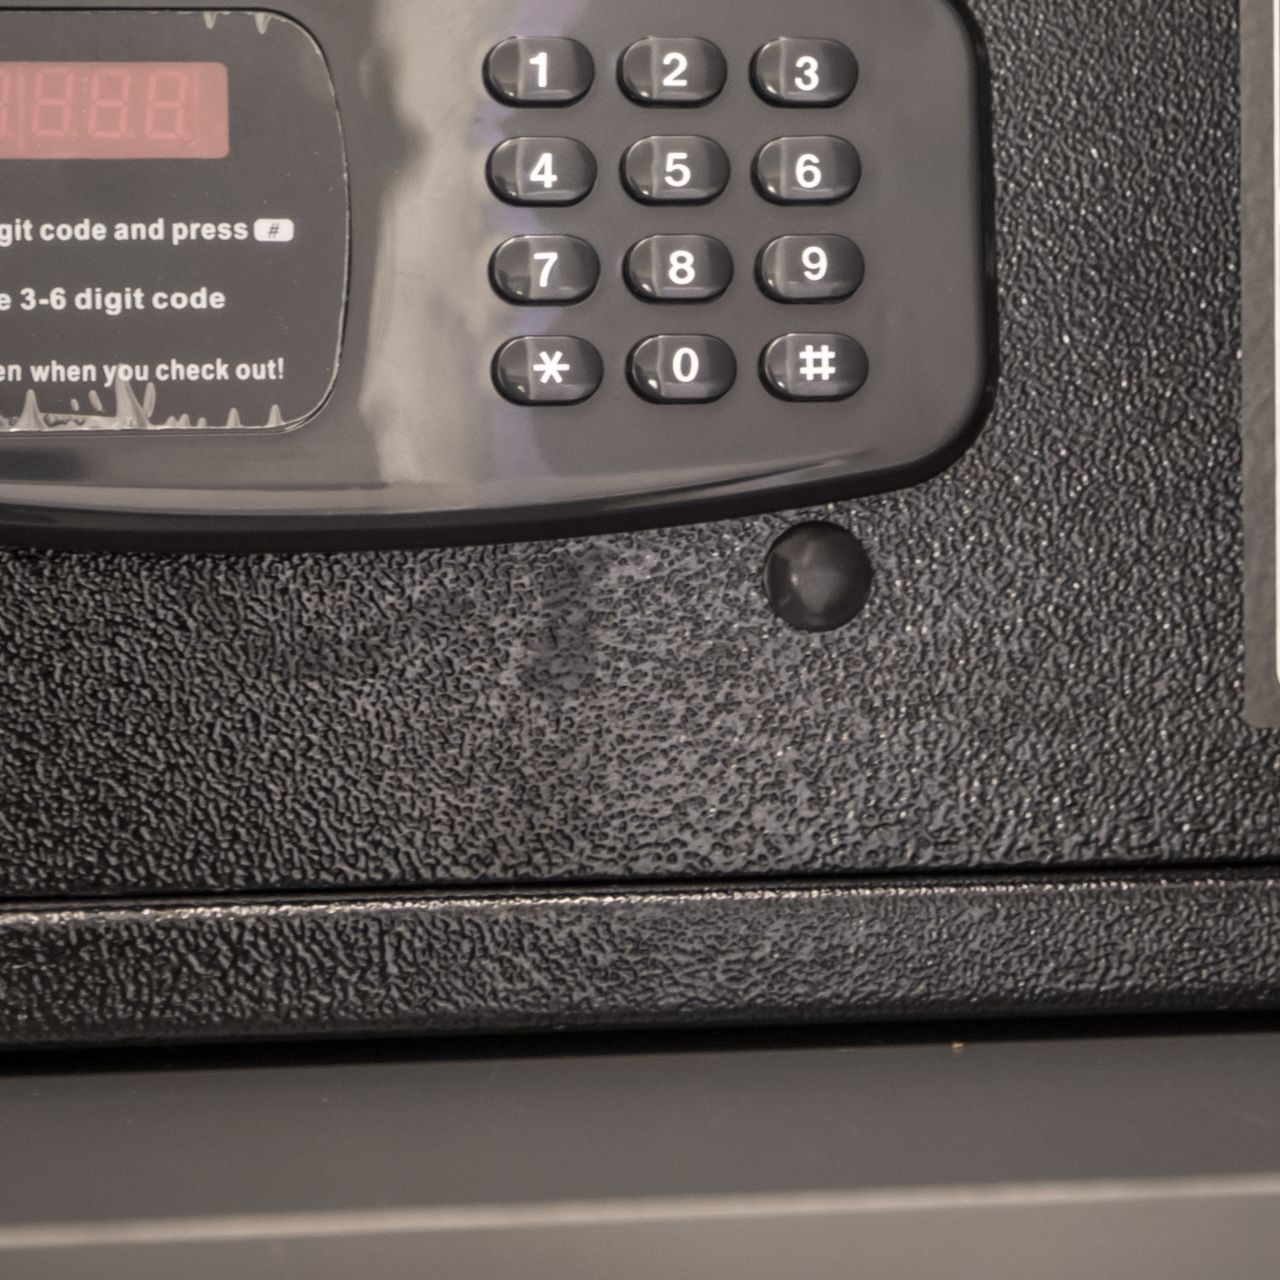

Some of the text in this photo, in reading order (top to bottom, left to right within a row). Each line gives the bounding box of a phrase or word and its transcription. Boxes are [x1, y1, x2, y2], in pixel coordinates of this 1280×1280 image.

[528, 51, 548, 88] 1
[662, 51, 688, 87] 2
[794, 55, 820, 92] 3
[528, 152, 558, 189] 4
[664, 151, 692, 188] 5
[795, 153, 822, 189] 6
[39, 217, 108, 242] code
[113, 217, 165, 241] and
[171, 222, 249, 246] press
[532, 251, 559, 288] 7
[668, 249, 696, 285] 8
[801, 245, 828, 281] 9
[20, 286, 67, 311] 3-6
[74, 287, 145, 316] digit
[151, 286, 226, 310] code
[29, 359, 99, 383] when
[103, 363, 150, 387] you
[155, 358, 230, 382] check
[235, 357, 286, 382] out!
[672, 346, 700, 383] 0
[798, 344, 836, 381] #
